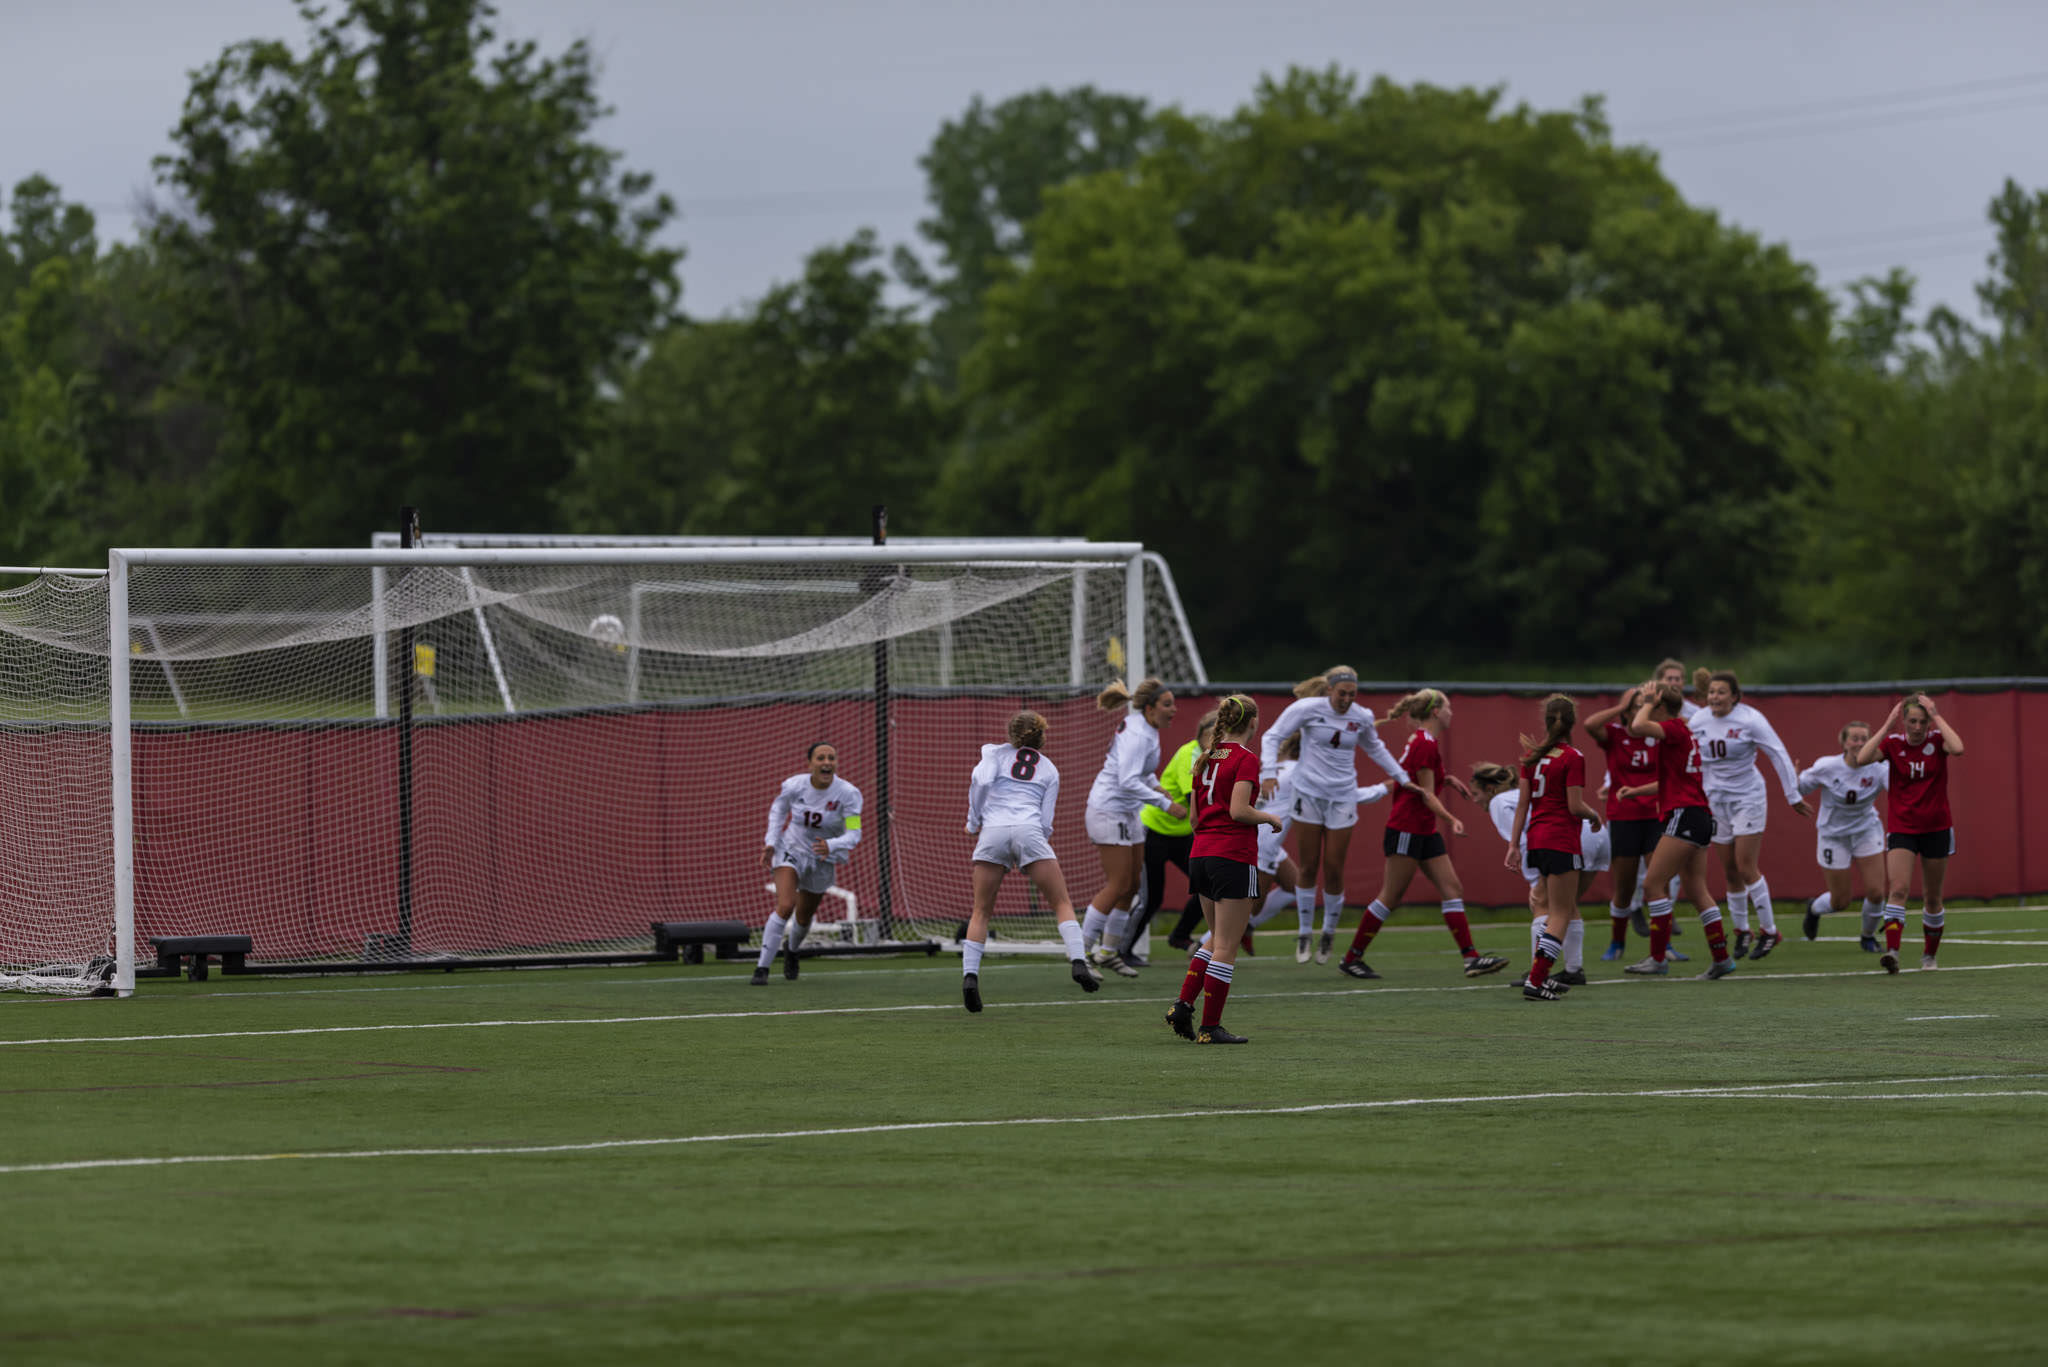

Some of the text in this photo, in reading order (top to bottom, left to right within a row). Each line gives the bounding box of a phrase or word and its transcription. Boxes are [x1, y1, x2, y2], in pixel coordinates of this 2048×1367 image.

[1330, 730, 1341, 748] 4
[1709, 740, 1726, 758] 10
[1011, 747, 1041, 781] 8
[1631, 750, 1649, 767] 21
[1531, 757, 1552, 798] 5
[1908, 760, 1925, 779] 14
[1201, 762, 1220, 806] 4
[1294, 797, 1302, 815] 4
[804, 811, 822, 829] 12
[1823, 848, 1833, 865] 9
